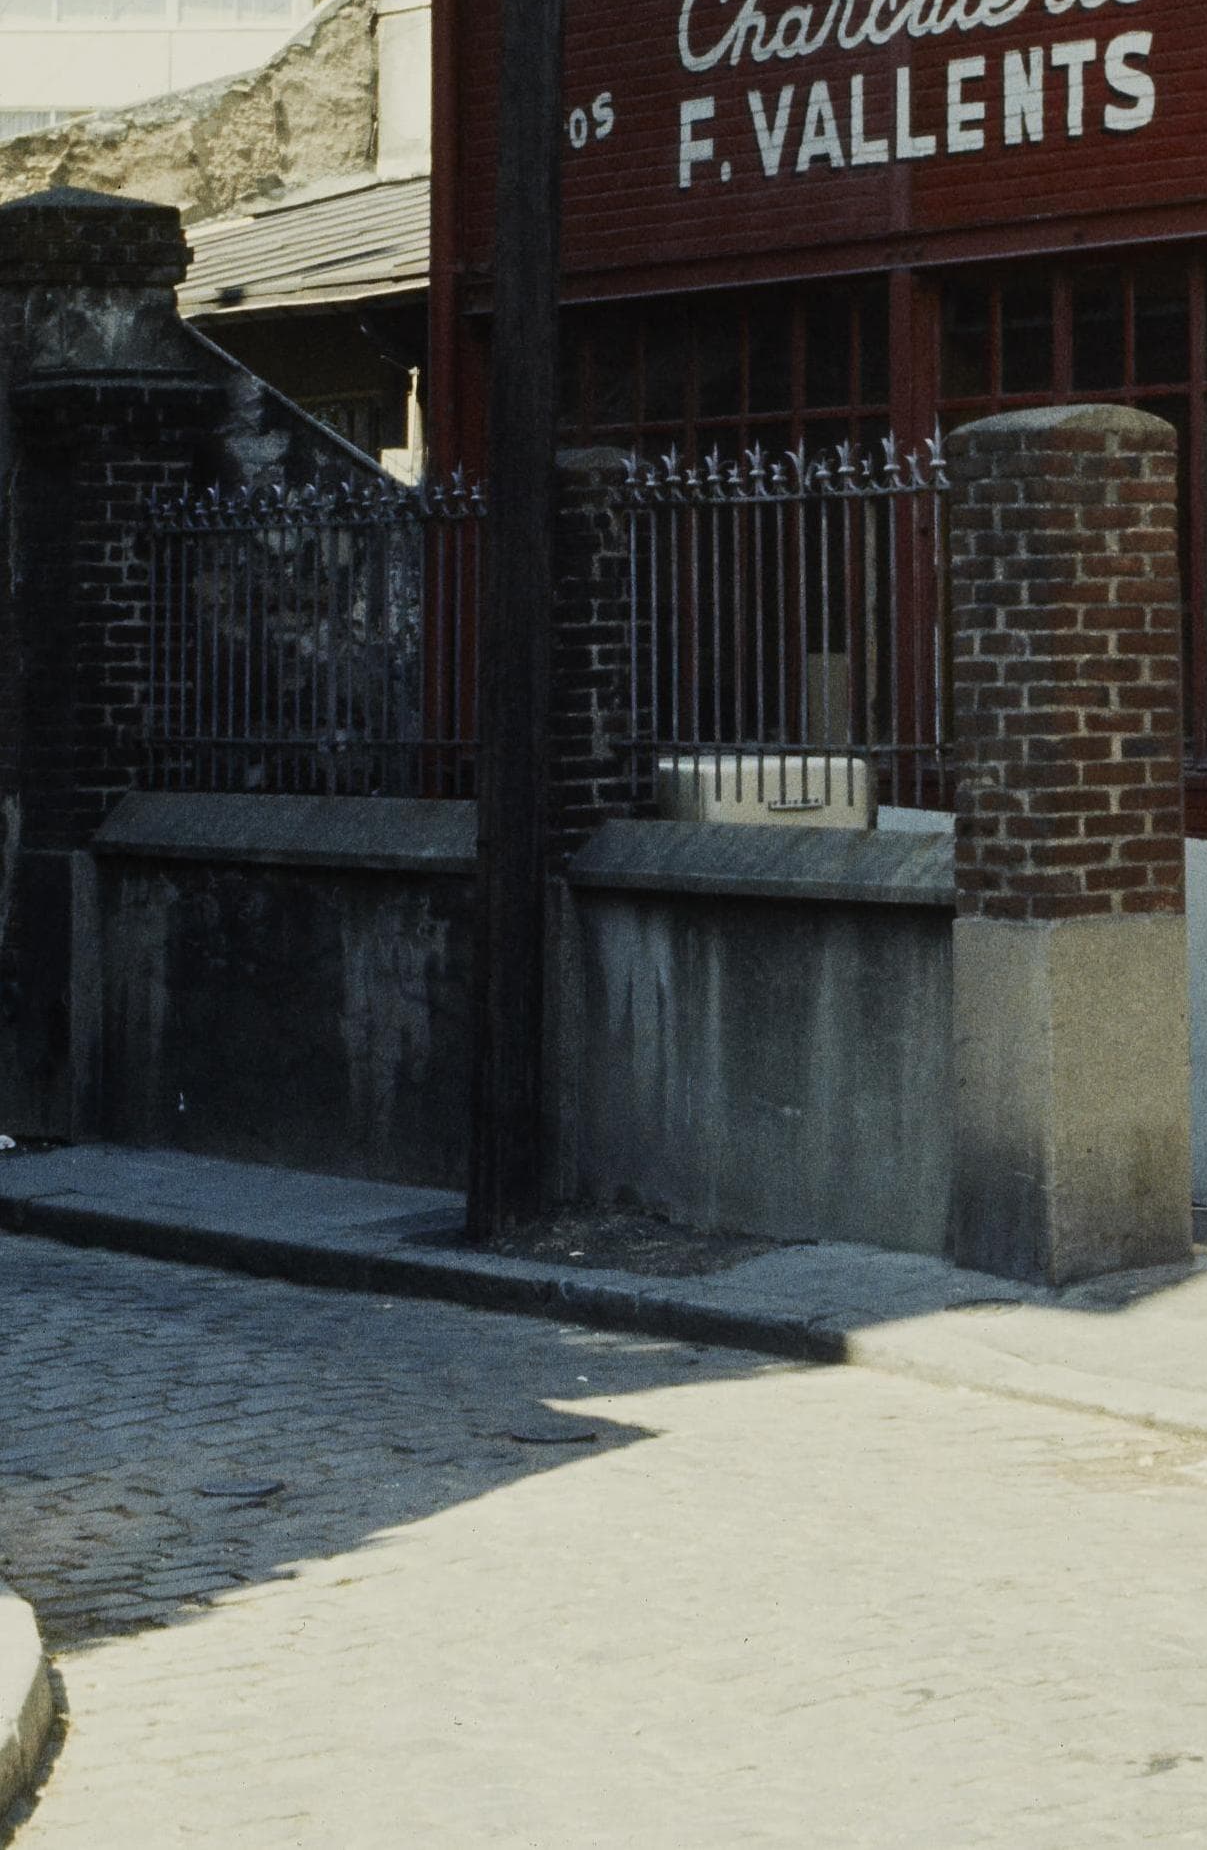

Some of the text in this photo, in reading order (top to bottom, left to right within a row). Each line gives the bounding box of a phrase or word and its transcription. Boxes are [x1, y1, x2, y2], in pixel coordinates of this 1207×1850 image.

[563, 92, 615, 149] os
[677, 30, 1157, 189] F. VALLENTS
